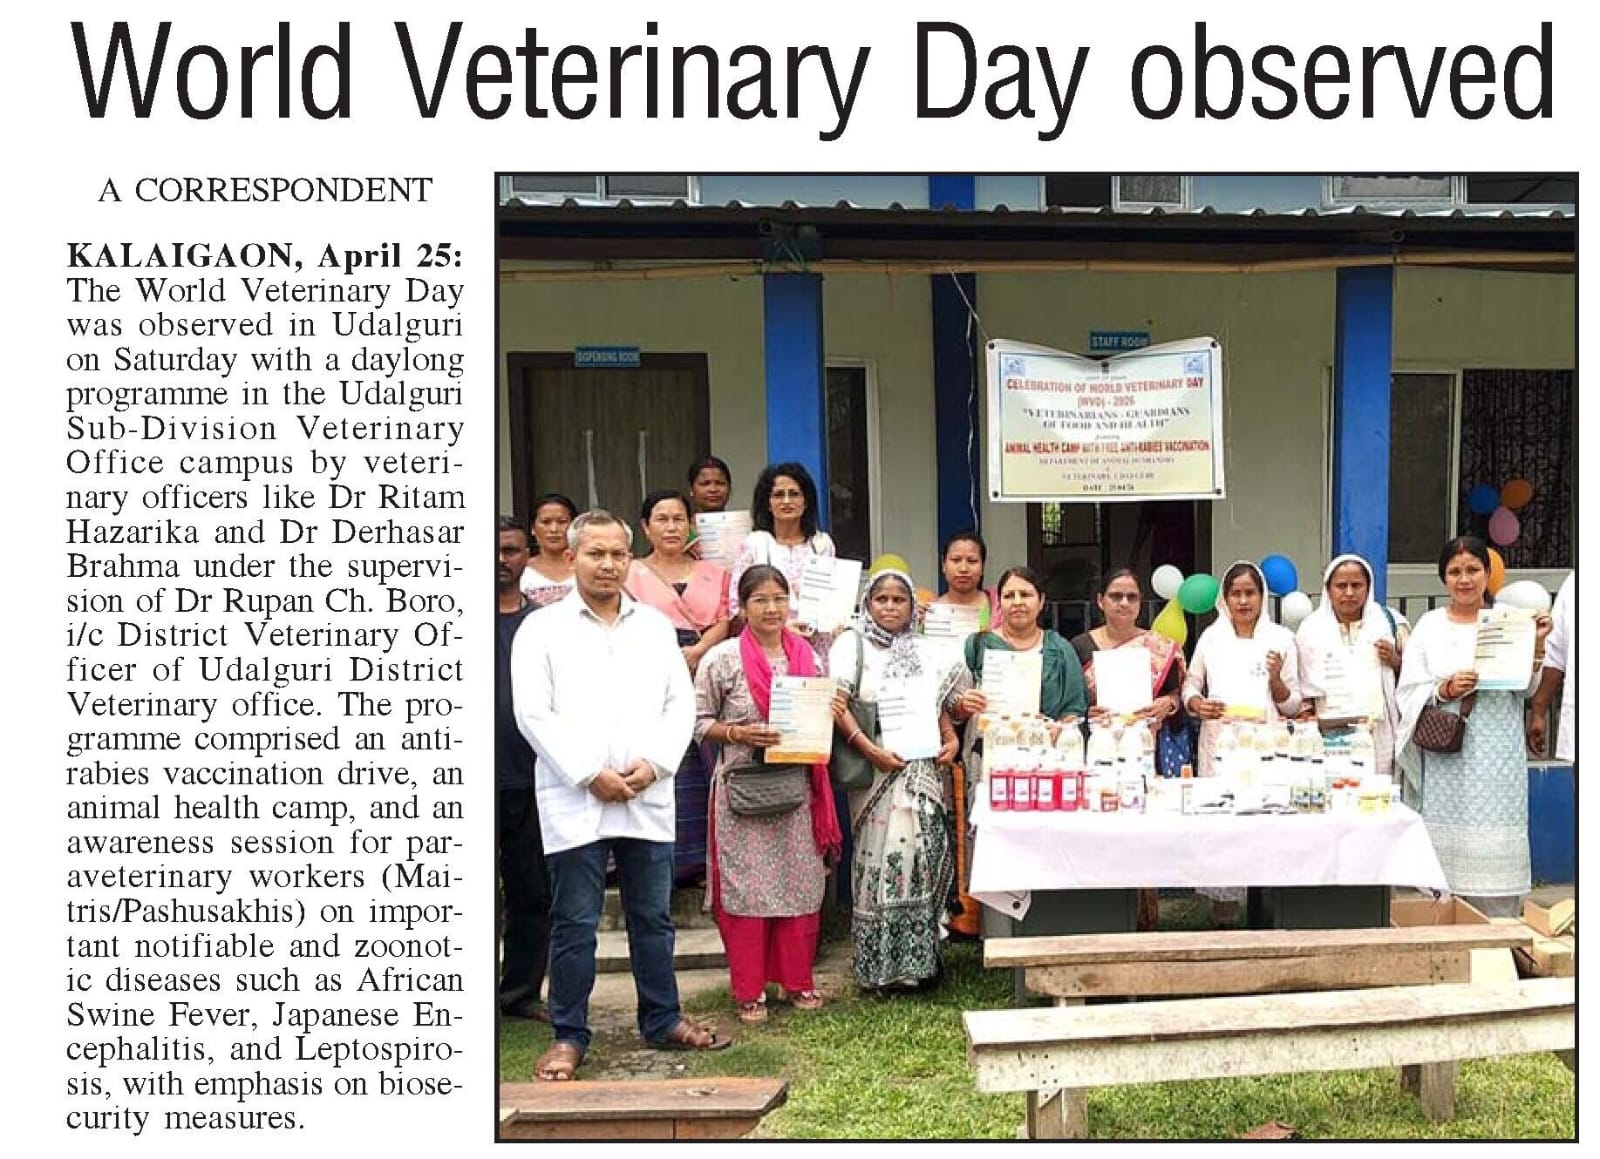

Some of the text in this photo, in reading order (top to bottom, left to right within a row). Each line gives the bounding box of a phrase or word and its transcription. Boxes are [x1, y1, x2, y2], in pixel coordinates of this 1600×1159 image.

[70, 21, 1553, 142] World Veterinary Day observed
[97, 177, 434, 202] A CORRESPONDENT
[66, 242, 461, 276] KALAIGAON, April 25:
[66, 277, 465, 310] The World Veterinary Day
[66, 311, 462, 344] was observed in Udalguri
[66, 346, 465, 379] on Saturday with a daylong
[65, 380, 462, 413] programme in the Udalguri
[1006, 378, 1072, 393] CELEBRATION
[1074, 382, 1087, 393] OF
[1089, 382, 1124, 393] WORLD
[1125, 378, 1184, 393] VETERINARY
[1186, 376, 1205, 388] DAY
[67, 415, 465, 448] Sub-Division Veterinary
[1005, 442, 1031, 454] ANIMAL
[1033, 441, 1059, 454] HEALTH
[1165, 440, 1209, 452] VACCINATION
[66, 448, 463, 482] Office campus by veteri-
[65, 483, 467, 517] nary officers like Dr Ritam
[65, 518, 465, 544] Hazarika and Dr Derhasar
[66, 552, 463, 586] Brahma under the supervi-
[67, 587, 463, 621] sion of Dr Rupan Ch. Boro,
[66, 621, 463, 654] i/c District Veterinary Of-
[66, 655, 463, 689] ficer of Udalguri District
[66, 690, 463, 724] Veterinary office. The pro-
[66, 725, 463, 758] gramme comprised an anti-
[66, 760, 465, 790] rabies vaccination drive, an
[67, 794, 465, 827] animal health camp, and an
[67, 828, 463, 862] awareness session for par-
[67, 863, 463, 896] aveterinary workers (Mai-
[67, 897, 463, 931] tris/Pashusakhis) on impor-
[66, 932, 463, 958] tant notifiable and zoonot-
[66, 966, 465, 992] ic diseases such as African
[67, 1001, 463, 1035] Swine Fever, Japanese En-
[66, 1035, 463, 1069] cephalitis, and Leptospiro-
[67, 1070, 463, 1103] sis, with emphasis on biose-
[66, 1105, 304, 1137] curity measures.
